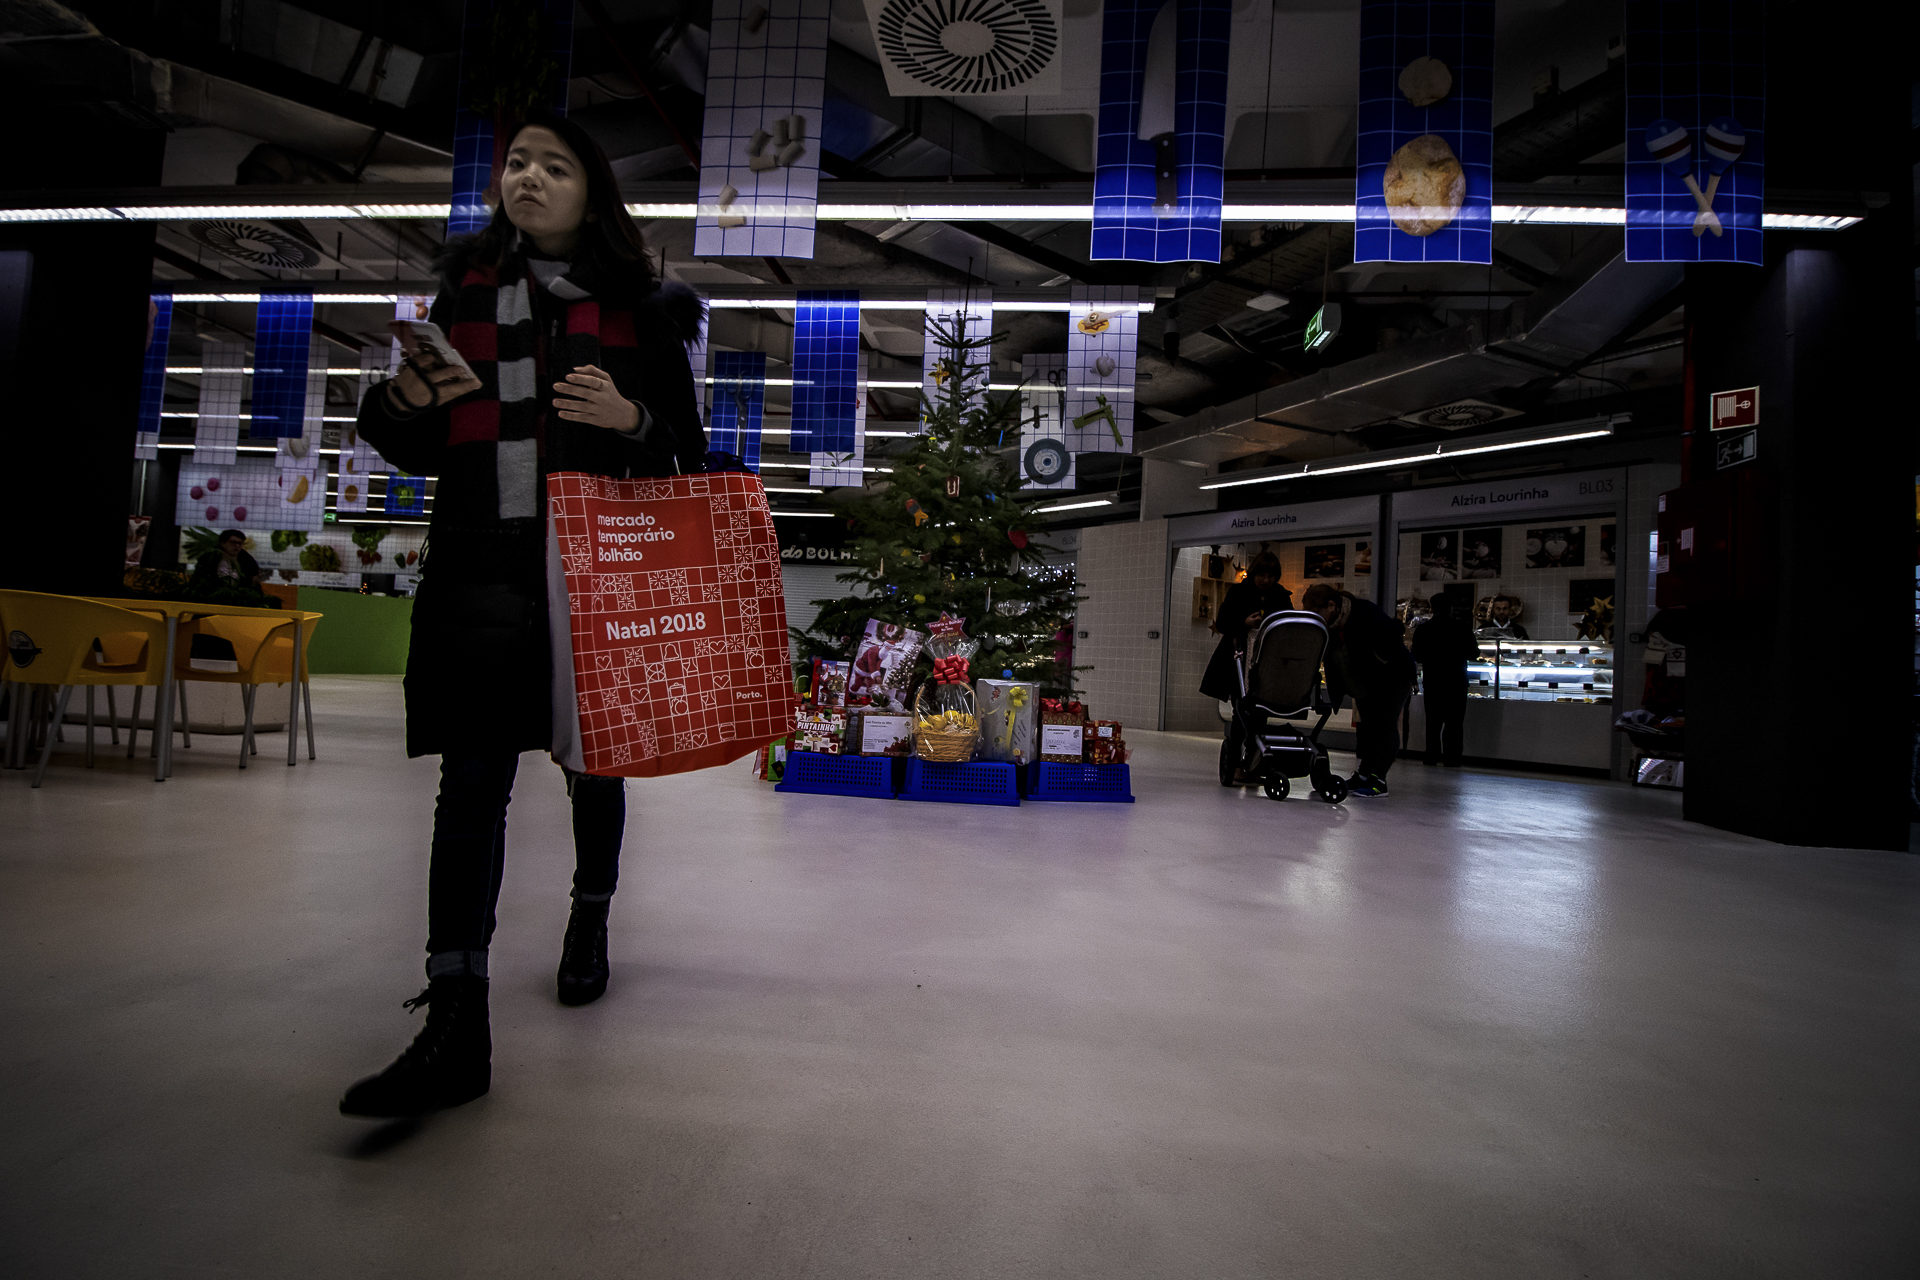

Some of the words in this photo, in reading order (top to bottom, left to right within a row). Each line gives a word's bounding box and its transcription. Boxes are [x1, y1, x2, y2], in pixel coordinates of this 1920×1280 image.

[1579, 479, 1613, 495] BL03
[1451, 494, 1486, 507] Alzira
[1490, 487, 1549, 503] Lourinha
[597, 512, 656, 527] mercado
[1231, 518, 1255, 528] Alzira
[1257, 514, 1297, 526] Lourinha
[597, 527, 675, 546] temporário
[598, 546, 643, 562] Bolhão
[605, 617, 656, 641] Natal
[659, 611, 707, 635] 2018
[736, 691, 763, 700] Porto.
[797, 721, 836, 732] PINTAINHO
